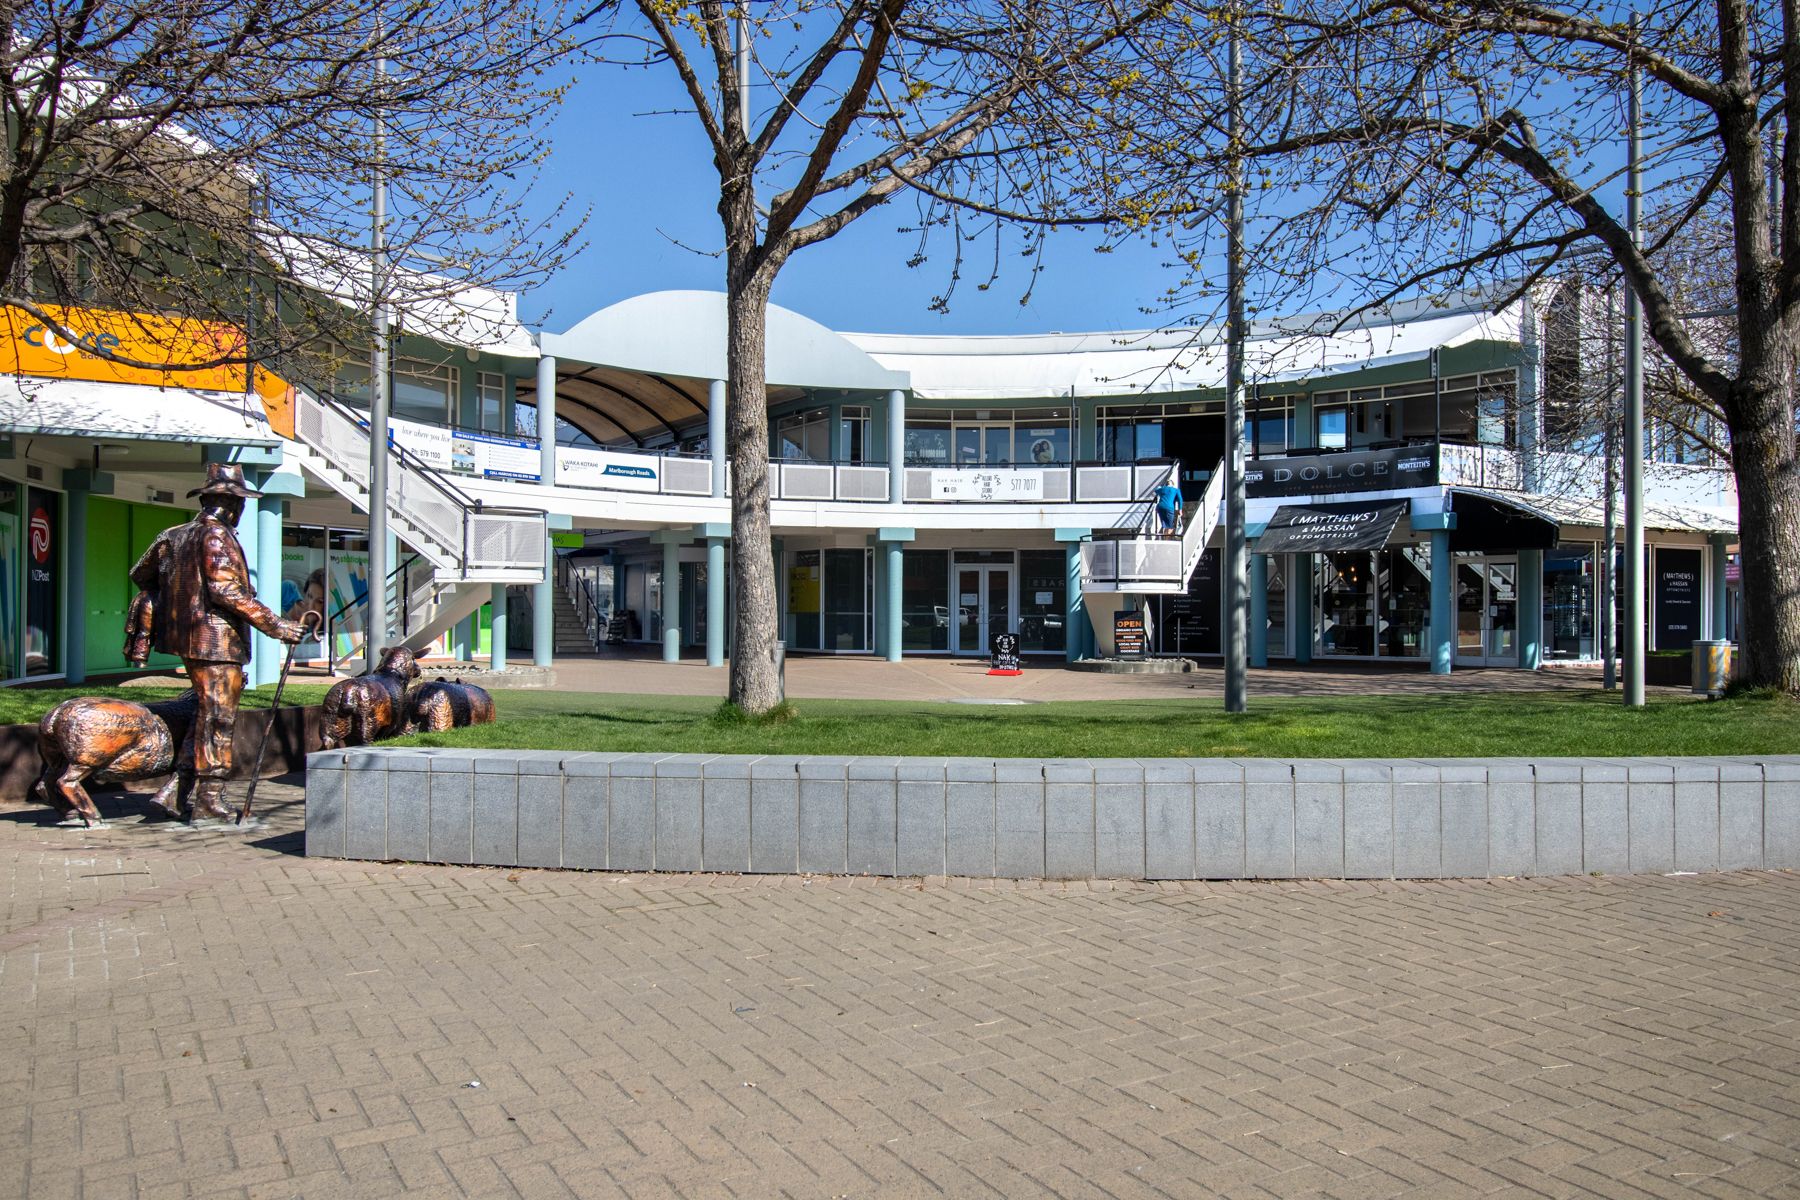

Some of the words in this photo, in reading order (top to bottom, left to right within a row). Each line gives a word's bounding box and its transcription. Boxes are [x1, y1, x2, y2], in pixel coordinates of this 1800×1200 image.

[1398, 460, 1430, 470] MONTEITH'S
[1274, 461, 1388, 482] DOLCE
[1011, 478, 1021, 490] 577
[1024, 479, 1036, 490] 7077
[1310, 524, 1356, 532] HASSAN
[1290, 532, 1358, 540] OPTOMETRISTS
